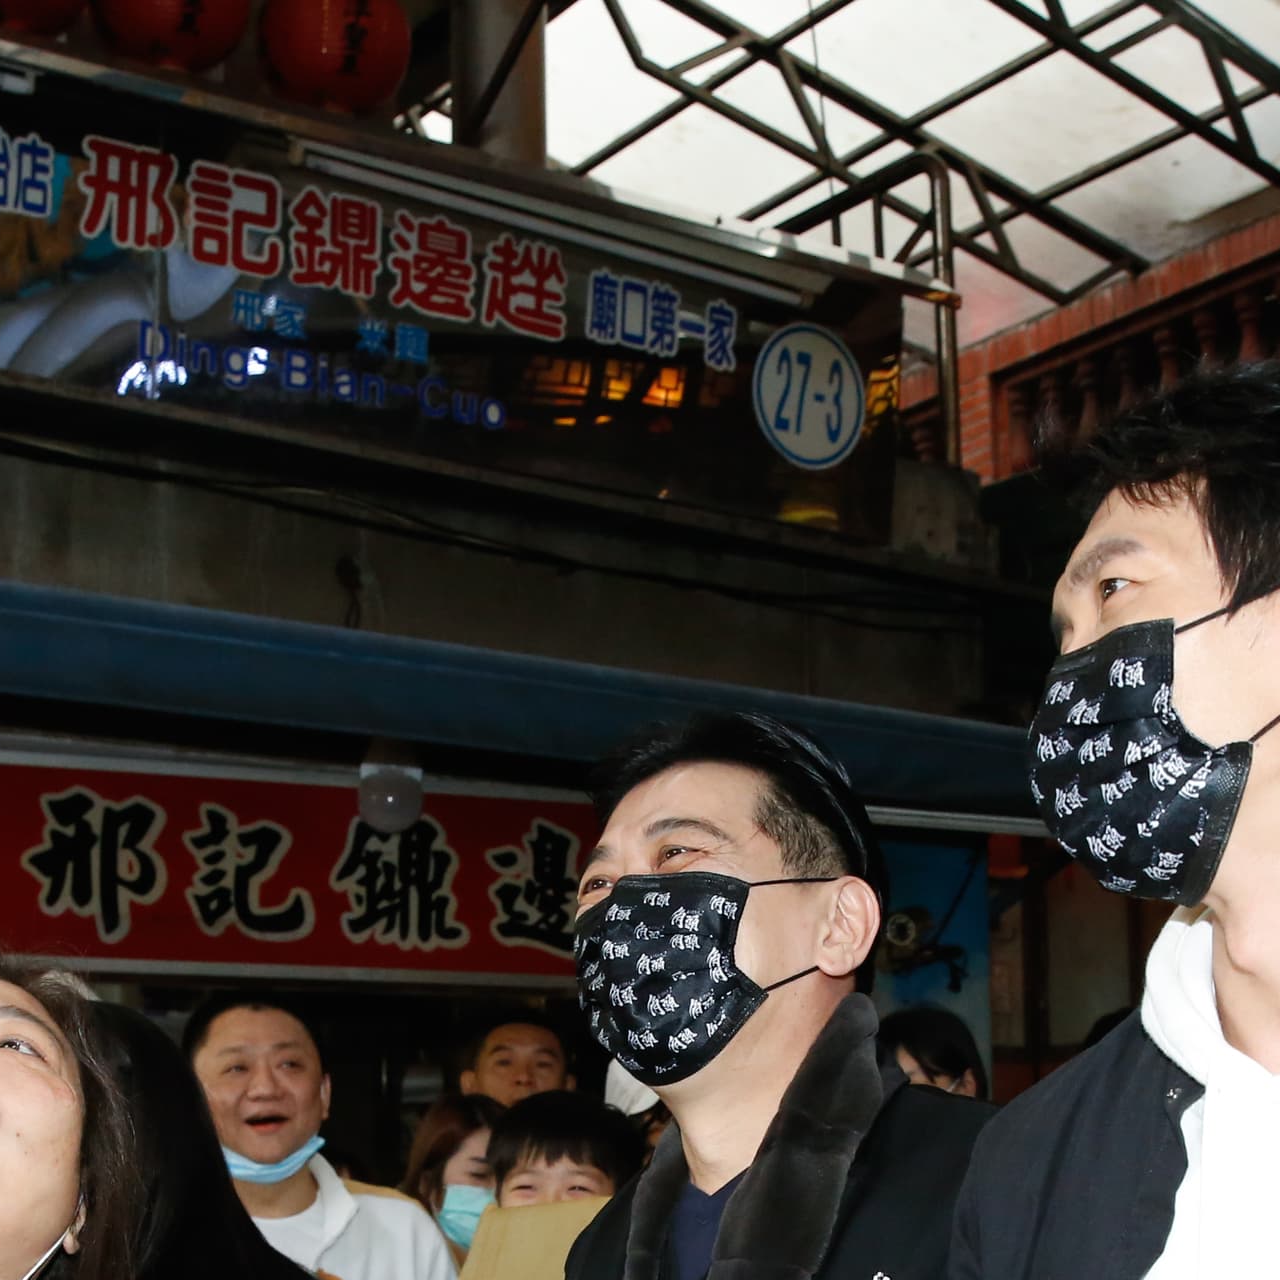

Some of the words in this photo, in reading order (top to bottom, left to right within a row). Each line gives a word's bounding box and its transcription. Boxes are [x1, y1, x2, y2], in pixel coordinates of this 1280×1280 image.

[589, 270, 735, 367] 廟口第一家
[775, 346, 843, 443] 27-3
